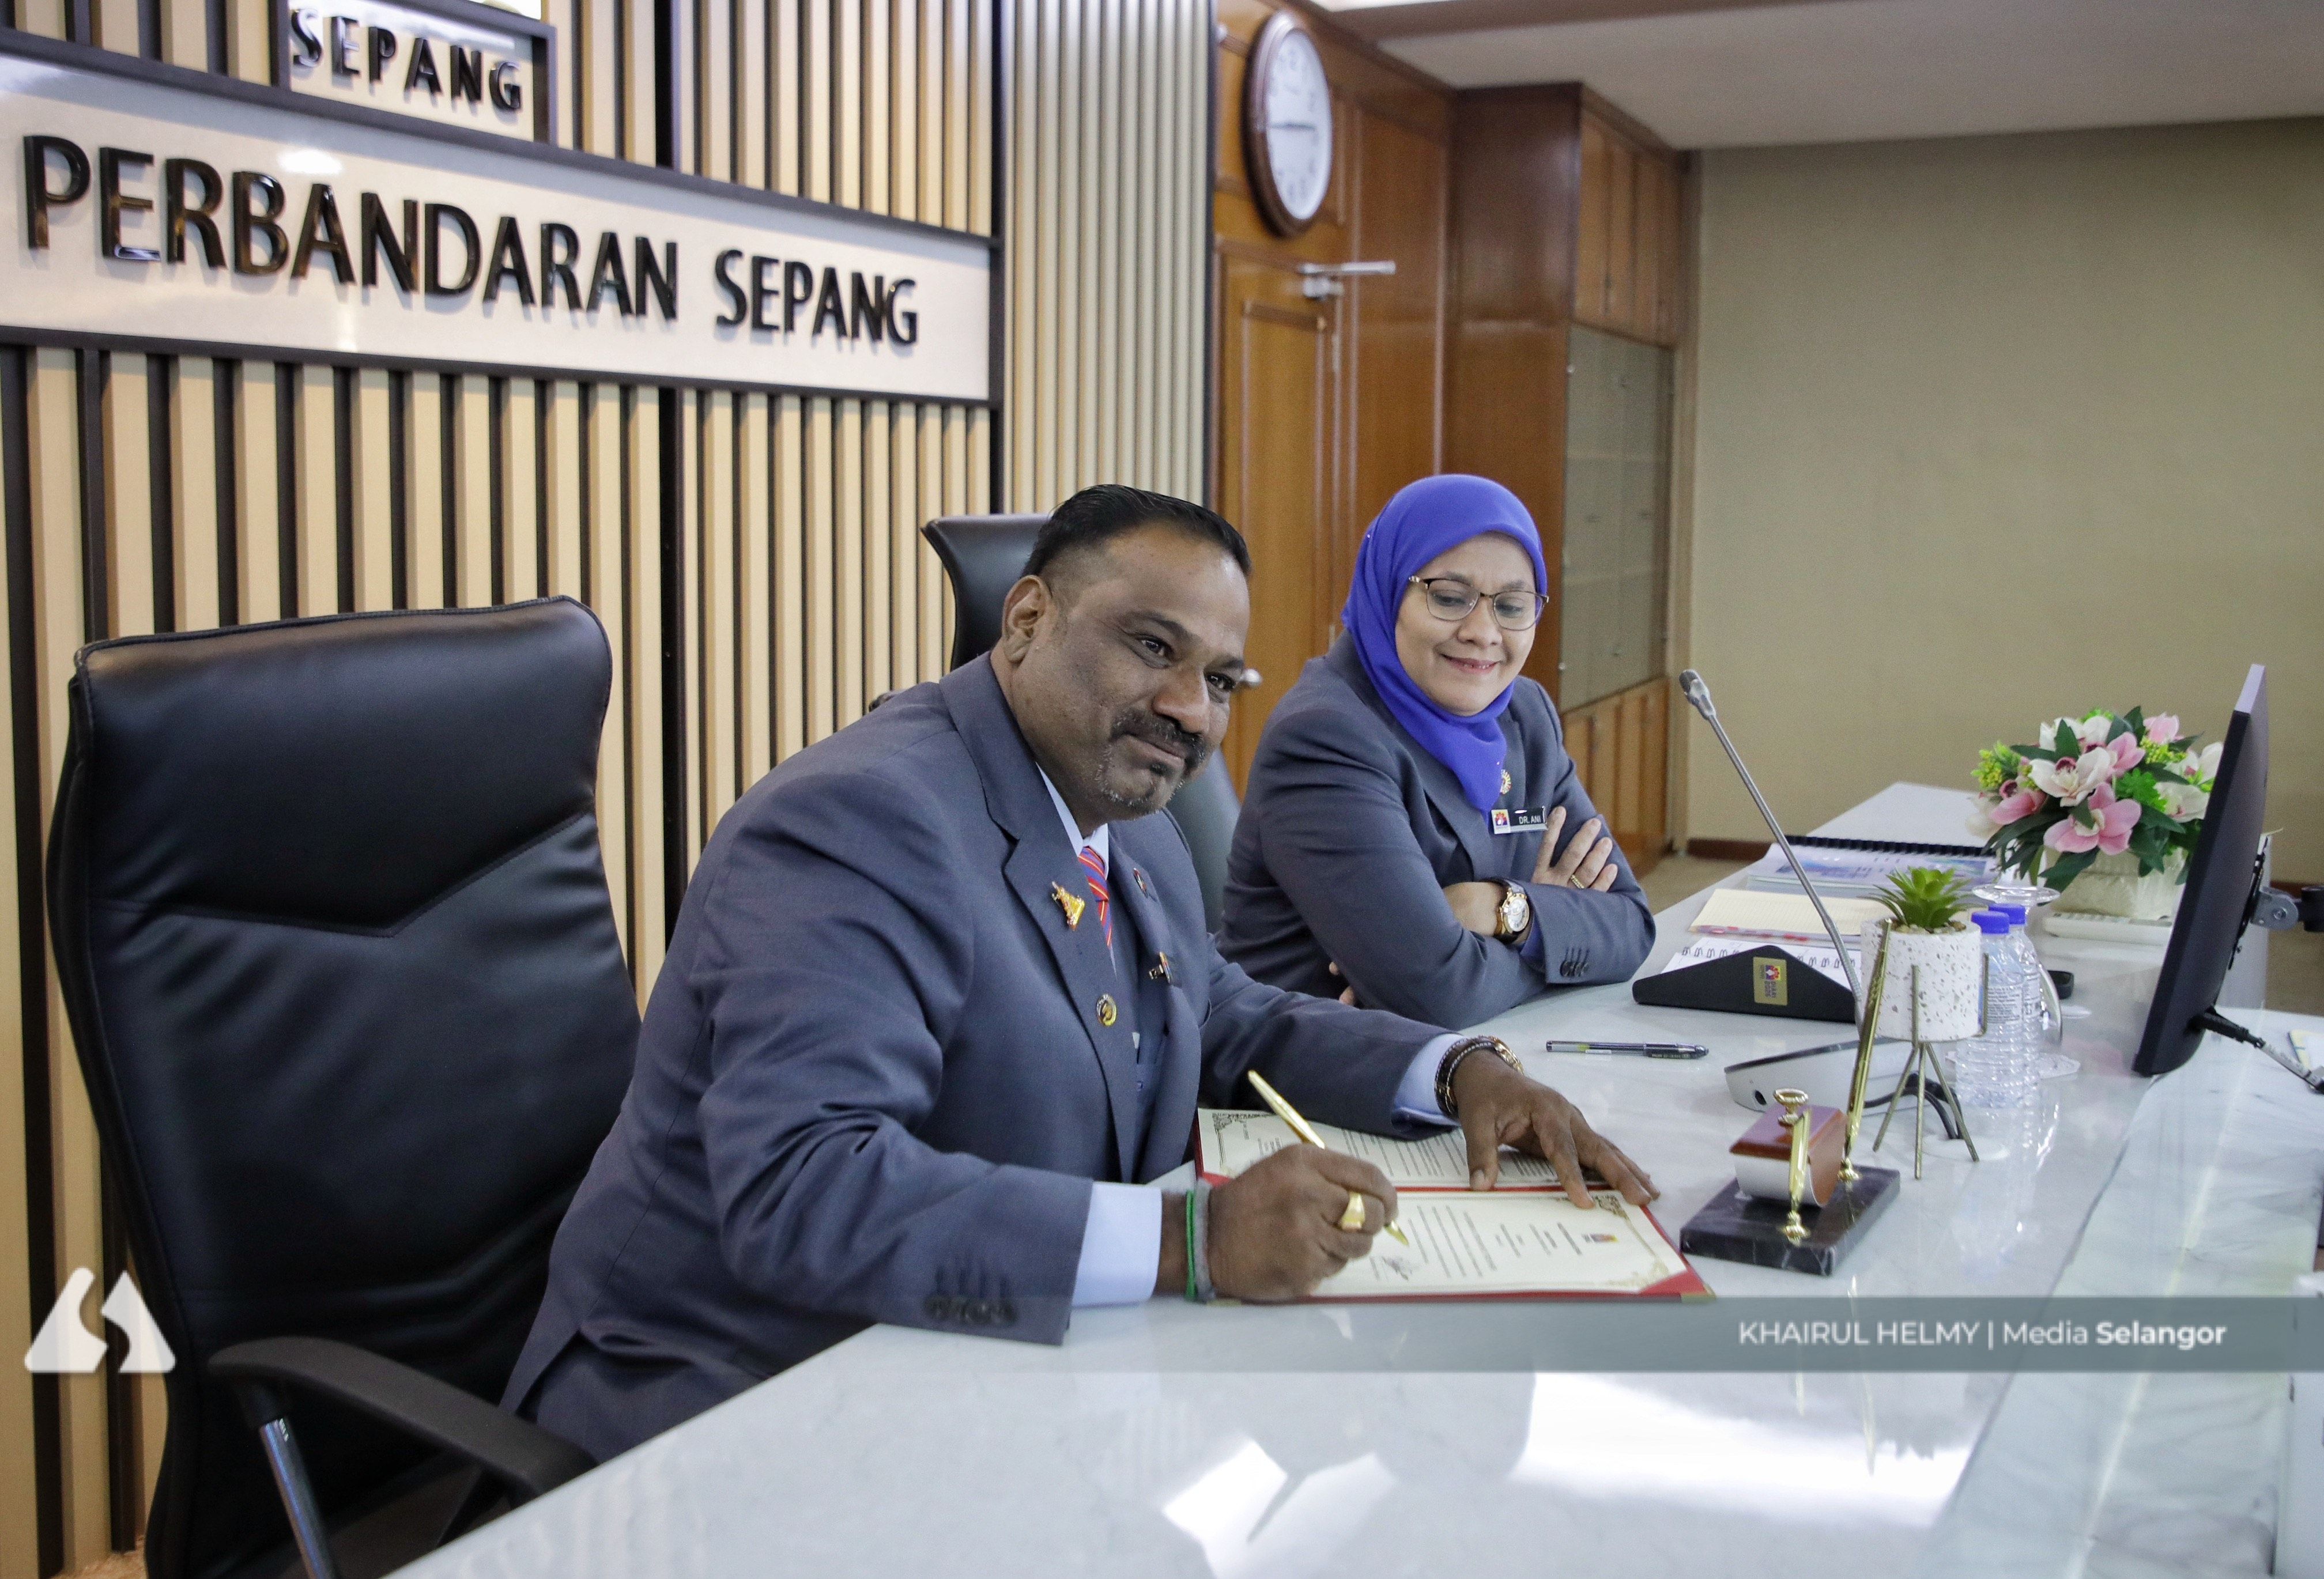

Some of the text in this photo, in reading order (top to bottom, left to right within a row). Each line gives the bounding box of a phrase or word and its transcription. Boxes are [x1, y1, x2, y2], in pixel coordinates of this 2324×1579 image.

[290, 8, 522, 112] SEPANG
[24, 135, 918, 345] PERBANDARAN SEPANG
[1518, 815, 1541, 824] DR. ANI
